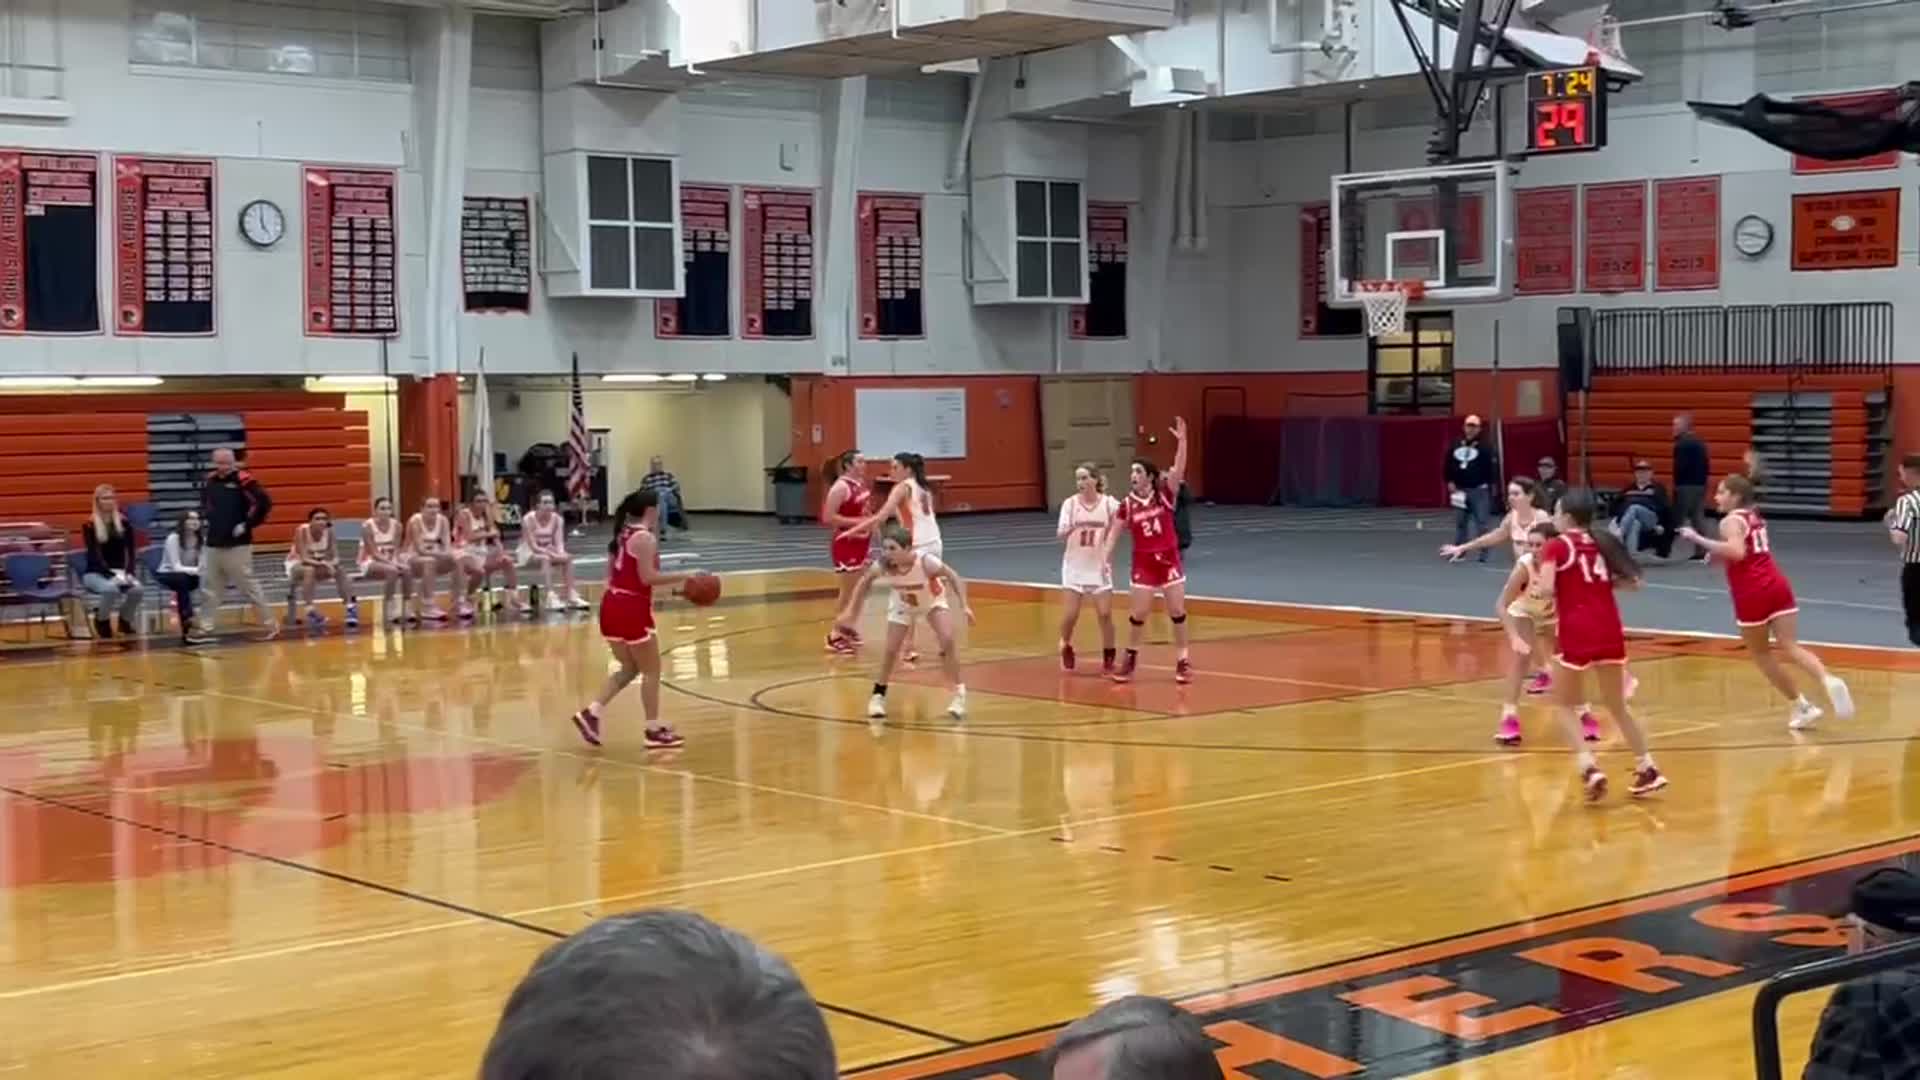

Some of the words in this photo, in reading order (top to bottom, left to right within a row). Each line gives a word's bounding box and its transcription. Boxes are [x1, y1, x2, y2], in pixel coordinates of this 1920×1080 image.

[1541, 71, 1592, 96] 7:24
[1536, 102, 1585, 148] 29
[1079, 530, 1096, 547] 11
[1140, 518, 1162, 537] 24
[1578, 552, 1608, 583] 14
